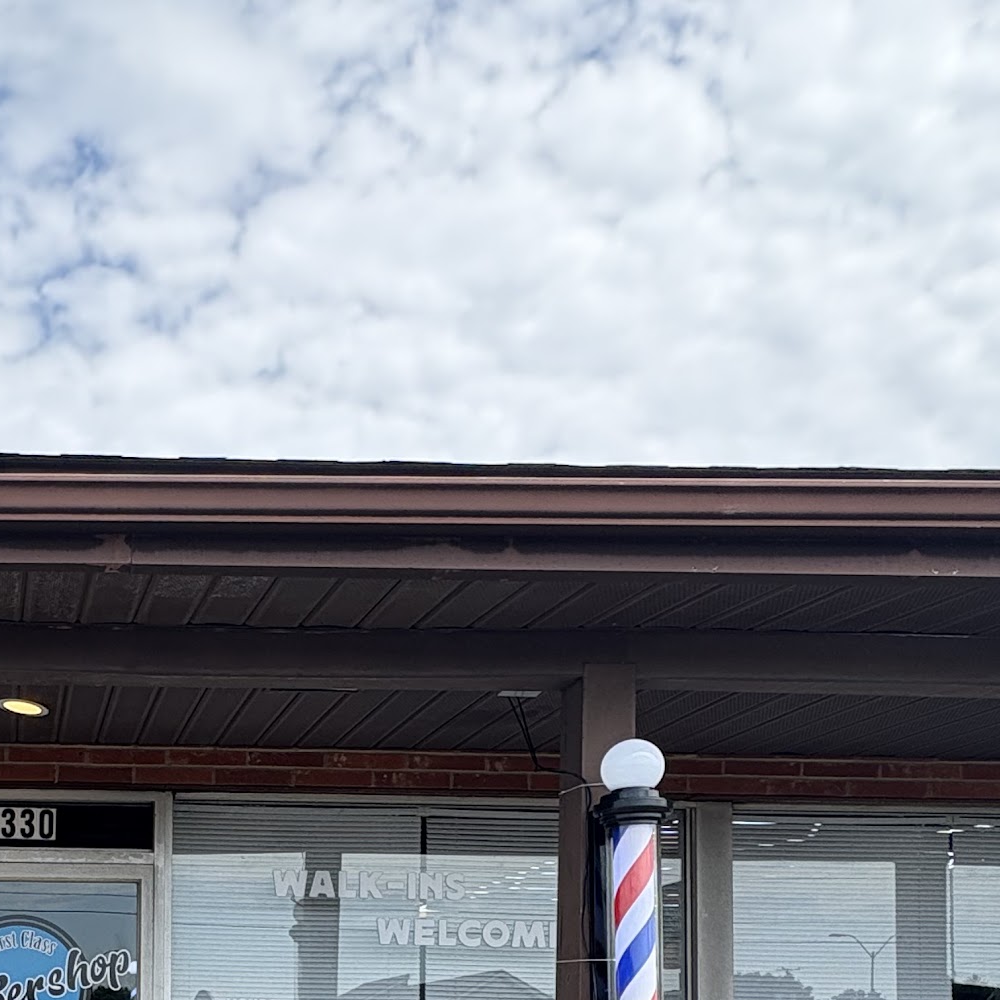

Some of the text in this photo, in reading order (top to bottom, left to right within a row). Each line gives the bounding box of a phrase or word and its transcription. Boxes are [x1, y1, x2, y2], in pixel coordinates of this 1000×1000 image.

[272, 868, 467, 901] WALK-INS
[19, 929, 58, 957] Class
[376, 917, 556, 949] WELCOM
